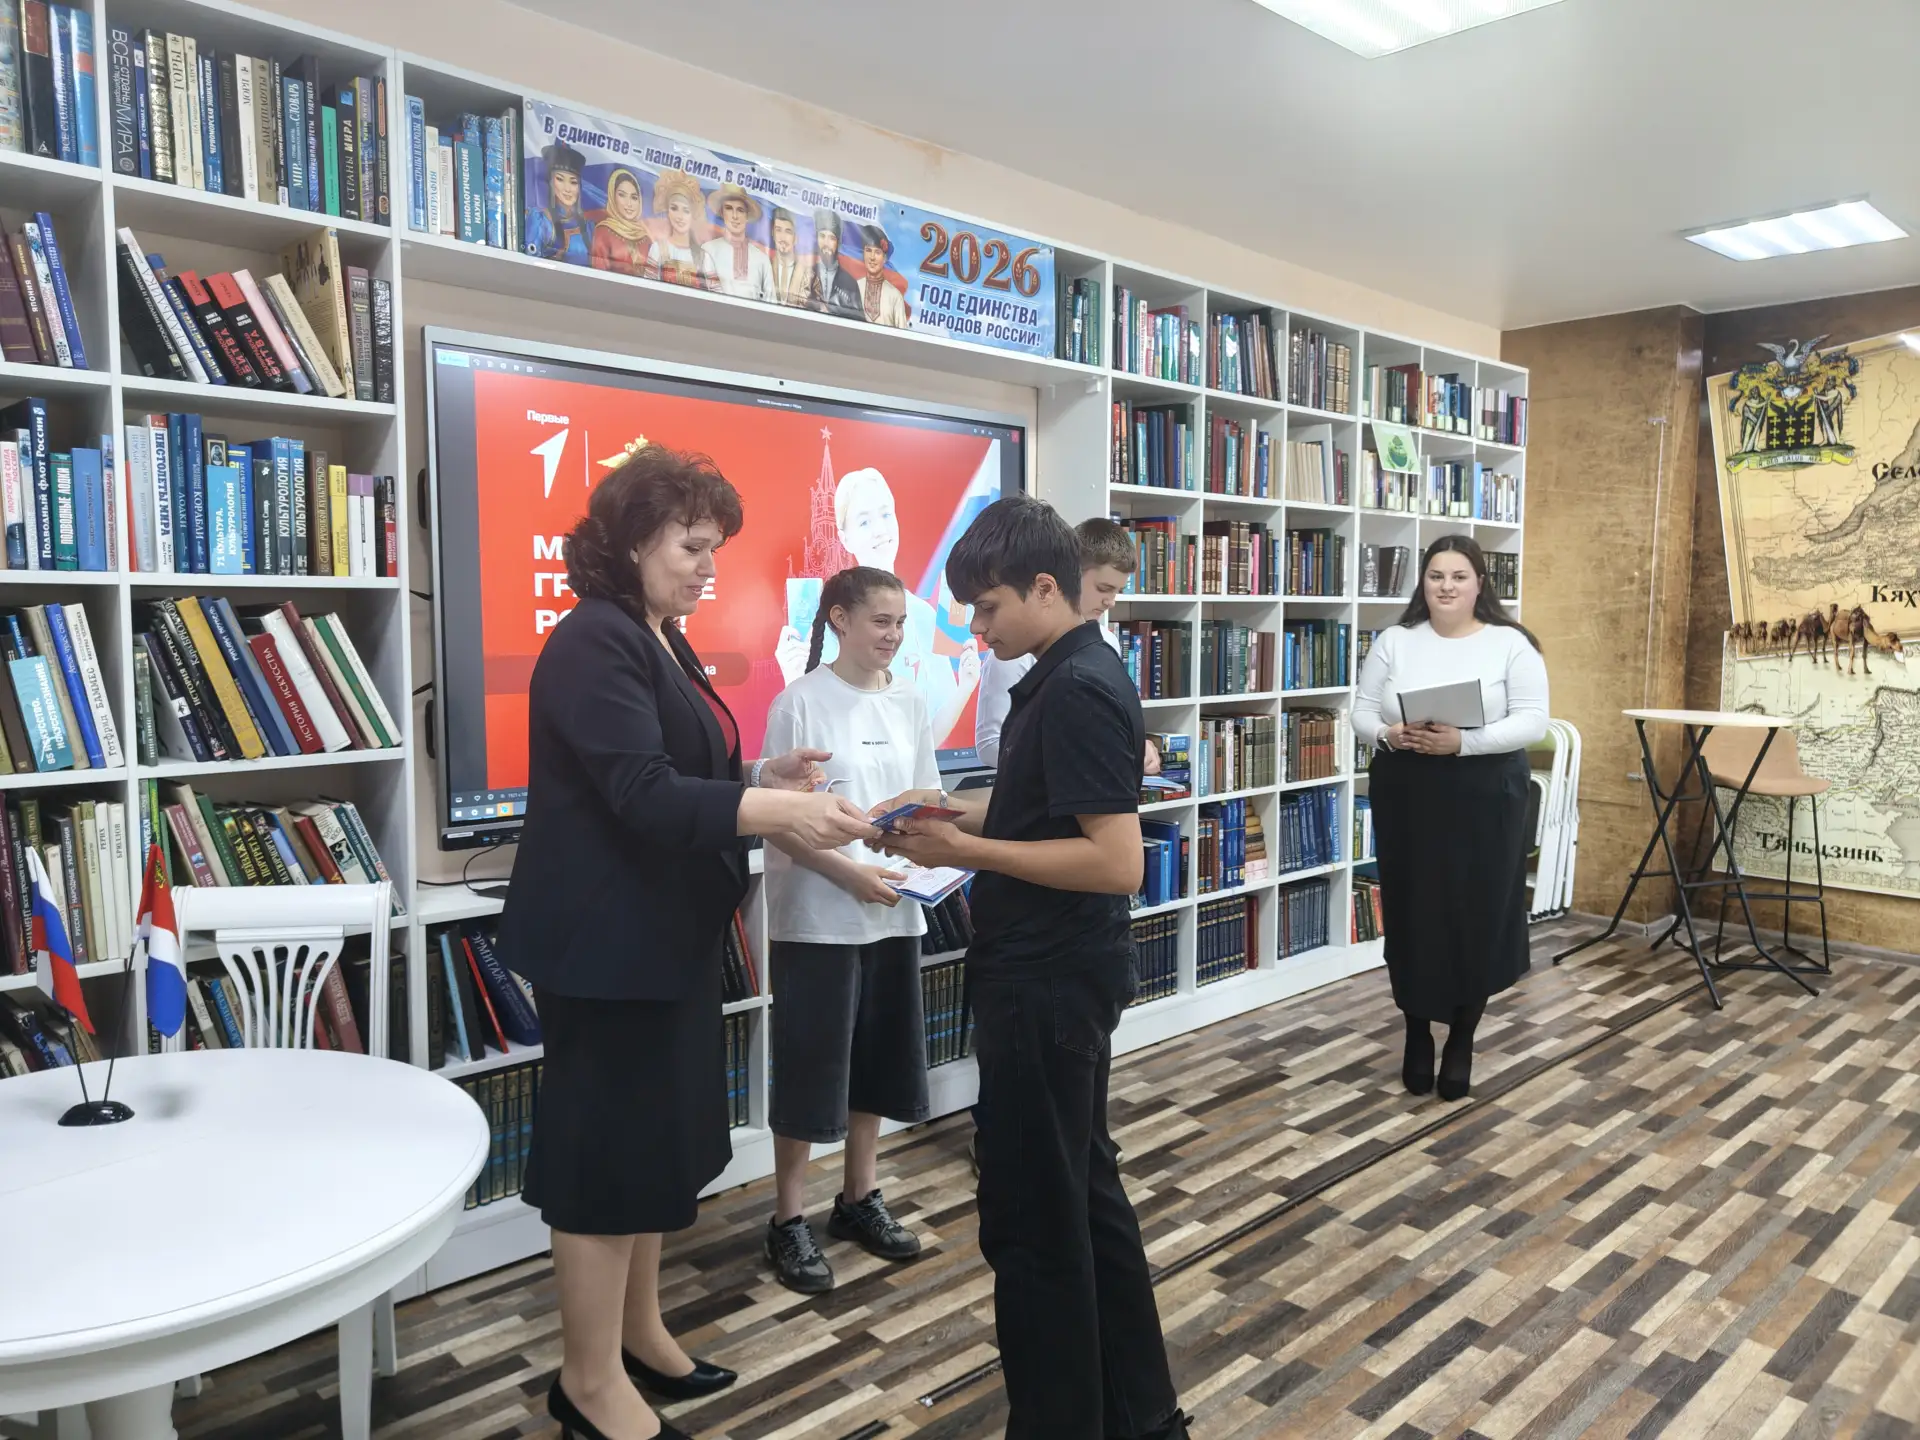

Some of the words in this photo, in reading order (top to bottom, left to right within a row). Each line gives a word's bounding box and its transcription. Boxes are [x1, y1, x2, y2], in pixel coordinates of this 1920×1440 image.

[111, 30, 129, 67] ВСЕ
[119, 66, 131, 104] страны
[169, 48, 184, 91] ГОРЫ
[204, 59, 213, 106] ЭНЦИКЛОПЕДИЯ
[241, 78, 250, 105] МОРЯ
[258, 75, 270, 148] ЛАНДШАФТЫ
[287, 83, 300, 121] СЛОВАРЬ
[306, 81, 314, 114] БУДУЩЕГО
[114, 103, 134, 153] МИРА
[207, 107, 216, 153] ЧЕРНОМОРСКАЯ
[342, 119, 353, 152] МИРА
[411, 121, 422, 149] НАРОДЫ
[308, 120, 317, 179] МУНИЦИПАЛИТЕТЫ
[413, 156, 423, 181] СТРАНЫ
[544, 116, 554, 134] В
[558, 123, 630, 155] единстве
[645, 147, 682, 170] наша
[685, 157, 721, 182] сила,
[725, 169, 733, 183] в
[736, 173, 789, 197] сердцах
[801, 189, 829, 207] одна
[832, 196, 877, 220] Россия!
[291, 162, 302, 188] МИР
[343, 154, 355, 200] СТРАНЫ
[460, 147, 472, 223] БИОЛОГИЧЕСКИЕ
[428, 170, 439, 225] ГЕОГРАФИЯ
[472, 194, 482, 223] НАУКИ
[463, 225, 471, 237] 28
[125, 257, 146, 291] СИМВОЛЫ
[920, 222, 1041, 297] 2026
[23, 278, 40, 312] ЯПОНИЯ
[140, 267, 192, 356] ГЕРАЛЬДИКА
[920, 284, 952, 310] ГОД
[956, 293, 1038, 326] ЕДИНСТВА
[354, 314, 362, 335] ФРОНТ
[919, 309, 982, 335] НАРОДОВ
[986, 323, 1041, 346] РОССИИ!
[217, 326, 253, 375] БИТВА
[245, 328, 284, 377] БИТВА
[356, 337, 364, 374] ВОСТОЧНЫЙ
[34, 416, 45, 457] России
[526, 409, 569, 425] Первые
[3, 448, 11, 470] СИЛА
[10, 449, 18, 482] РОССИИ
[38, 459, 49, 490] флот
[152, 432, 169, 502] ПИСТОЛЕТЫ
[1872, 462, 1920, 480] Сел
[5, 472, 14, 513] МОРСКАЯ
[57, 466, 71, 494] ЛОДКИ
[275, 456, 291, 537] КУЛЬТУРОЛОГИЯ
[291, 457, 308, 537] КУЛЬТУРОЛОГИЯ
[38, 493, 51, 558] Подводный
[58, 496, 74, 544] ПОДВОДНЫЕ
[158, 503, 171, 536] МИРА
[178, 491, 186, 527] ЛОДКИ
[192, 491, 205, 539] КОРАБЛИ
[224, 481, 238, 555] КУЛЬТУРОЛОГИЯ
[108, 523, 116, 566] СОВРЕМЕННЫЕ
[214, 507, 226, 553] КУЛЬТУРА.
[216, 556, 225, 566] 71
[1871, 584, 1920, 608] Кях
[163, 600, 192, 646] БРЮЛЛОВ
[206, 604, 227, 634] ВРУБЕЛЬ
[156, 622, 184, 666] КОСТЮМА
[183, 642, 202, 666] Карл
[220, 634, 240, 662] МИХАИЛ
[85, 666, 104, 709] БАММЕС
[177, 666, 202, 706] ИСТОРИЯ
[259, 646, 294, 699] ИСКУССТВА
[35, 662, 66, 750] ИСКУССТВОЗНАНИЕ
[286, 699, 315, 742] ИСТОРИЯ
[32, 698, 54, 756] ИСКУССТВО.
[98, 713, 118, 756] Готфрид
[46, 751, 56, 764] 85
[63, 826, 74, 865] УКРАШЕНИЯ
[97, 827, 108, 850] РЕРИХ
[231, 836, 257, 880] ПЕЙЗАЖА
[246, 833, 272, 878] ПОРТРЕТА
[262, 832, 290, 884] НАТЮРМОРТА
[69, 867, 77, 903] НАРОДНЫЕ
[72, 908, 82, 936] РУССКИЕ
[472, 932, 508, 985] ЭРМИТАЖ
